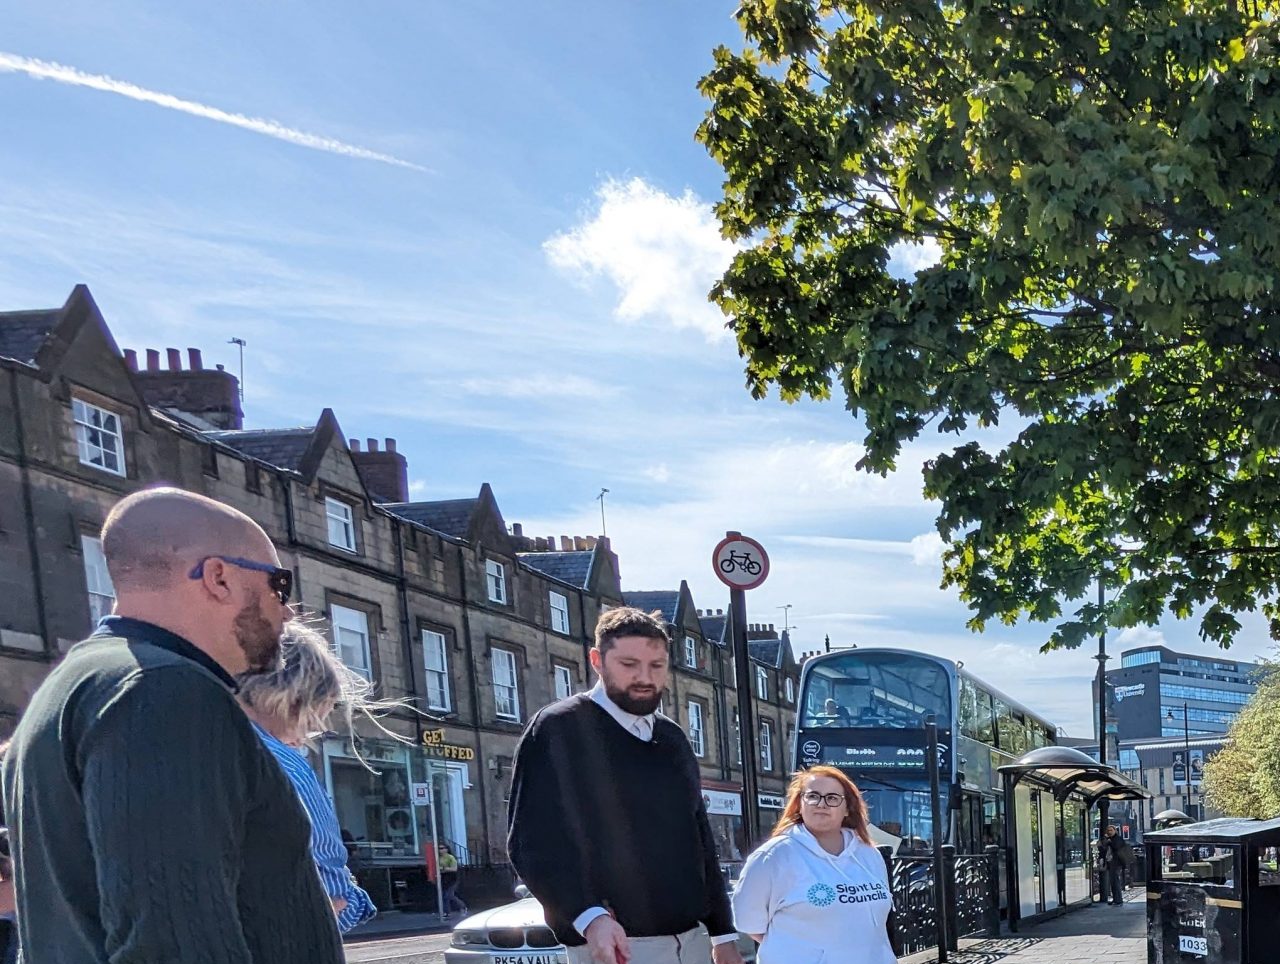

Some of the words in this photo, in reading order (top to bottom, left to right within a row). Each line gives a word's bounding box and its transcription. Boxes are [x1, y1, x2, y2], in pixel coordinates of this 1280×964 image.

[422, 728, 446, 743] GET
[836, 883, 869, 895] Sight
[838, 890, 888, 904] Councils
[1181, 938, 1207, 951] 1033
